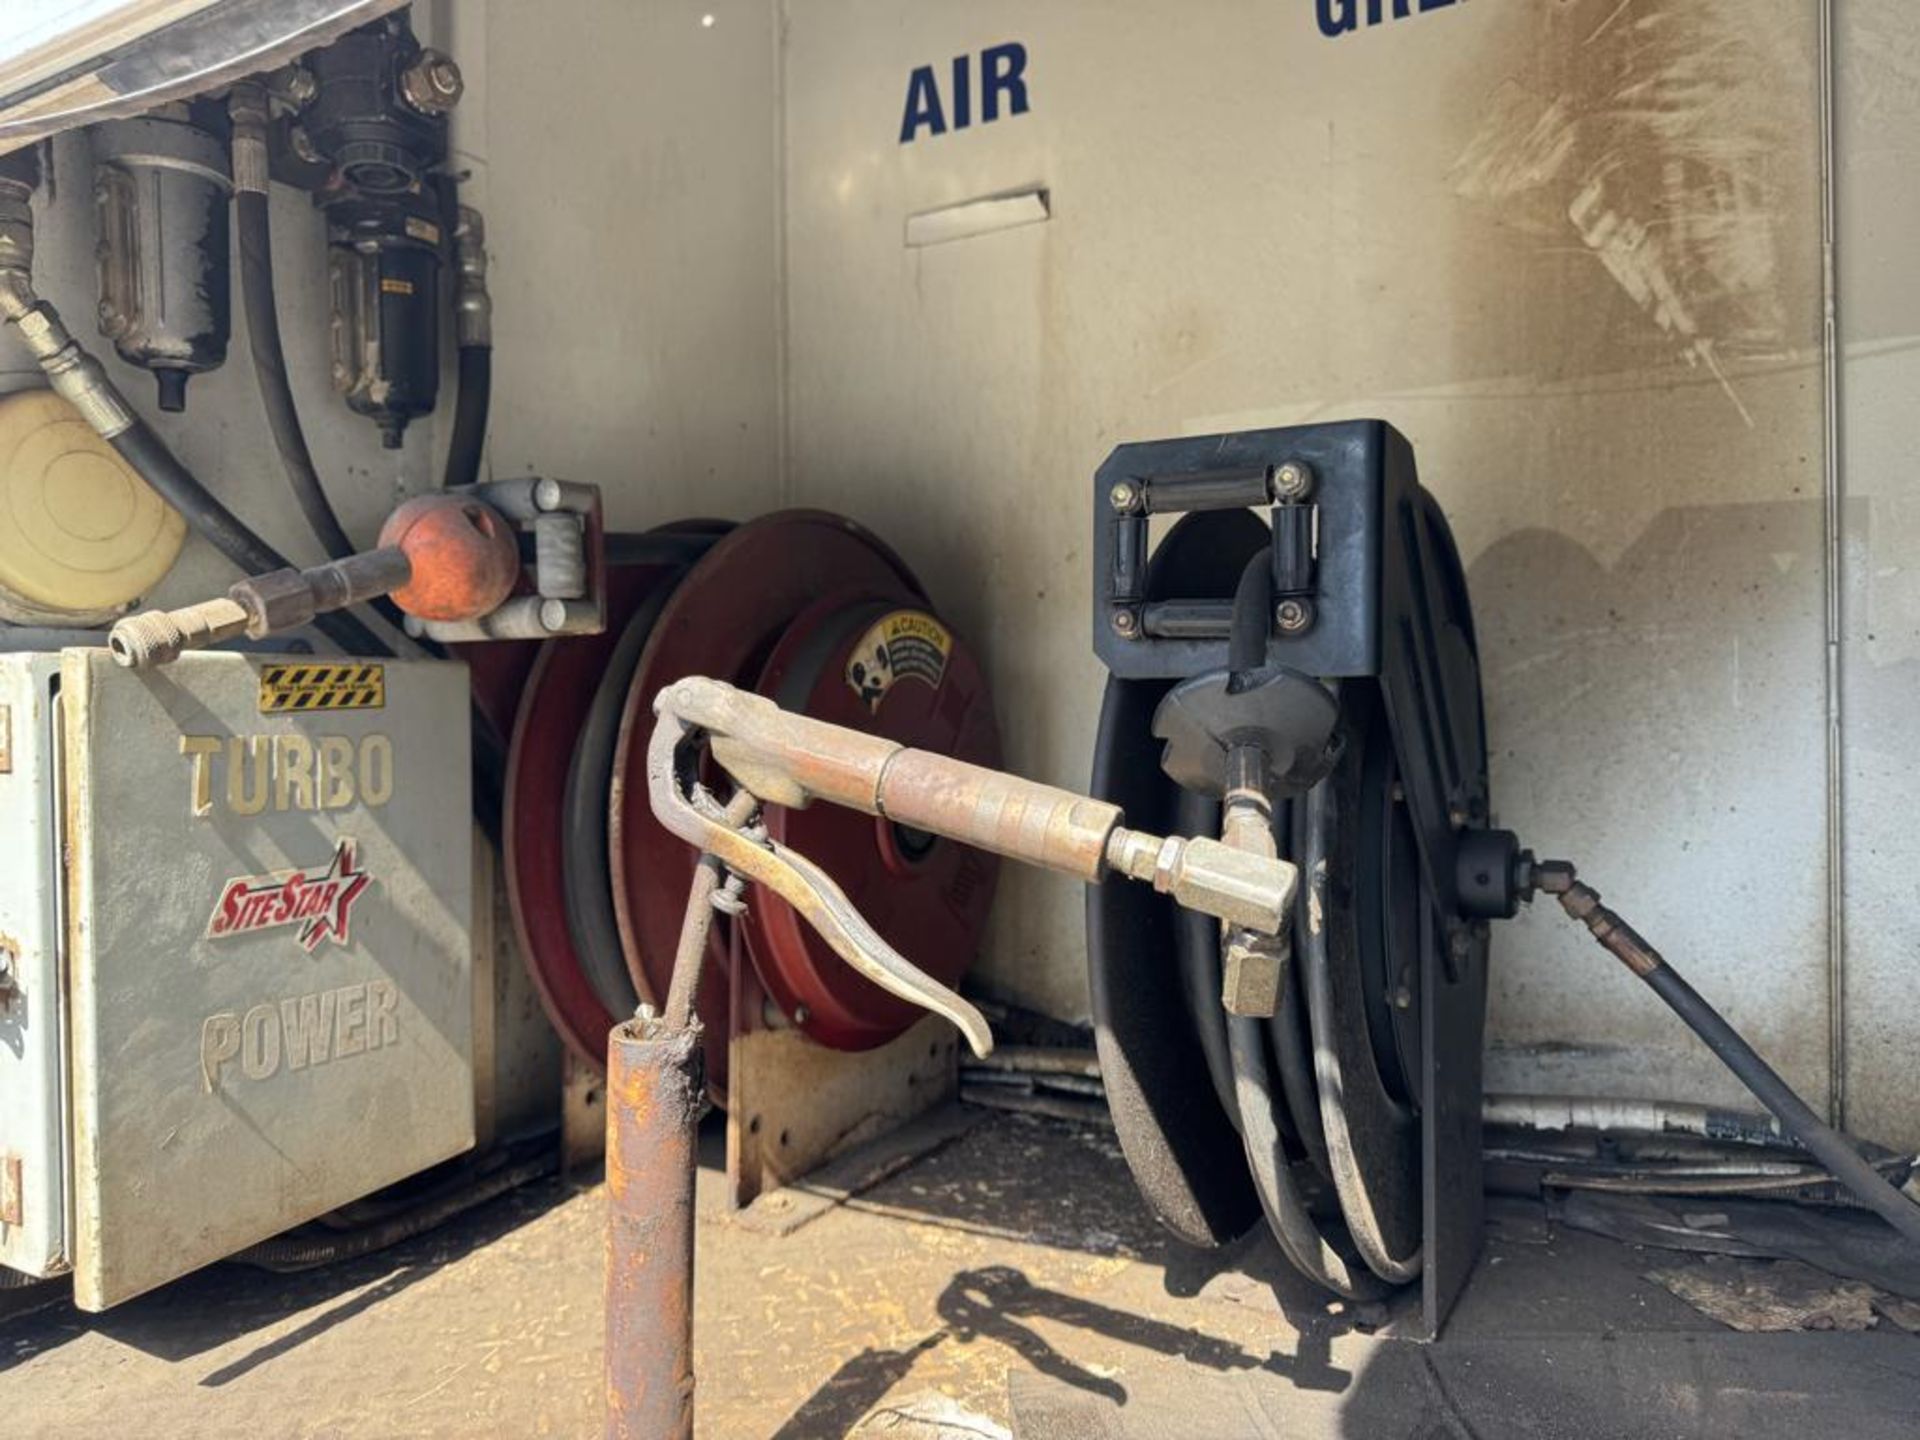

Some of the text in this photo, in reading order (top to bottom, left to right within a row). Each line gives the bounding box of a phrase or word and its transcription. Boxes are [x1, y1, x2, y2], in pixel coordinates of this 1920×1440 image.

[899, 41, 1030, 144] AIR
[900, 615, 945, 647] CAUTION
[180, 733, 395, 817] TURBO
[201, 977, 399, 1094] POWER
